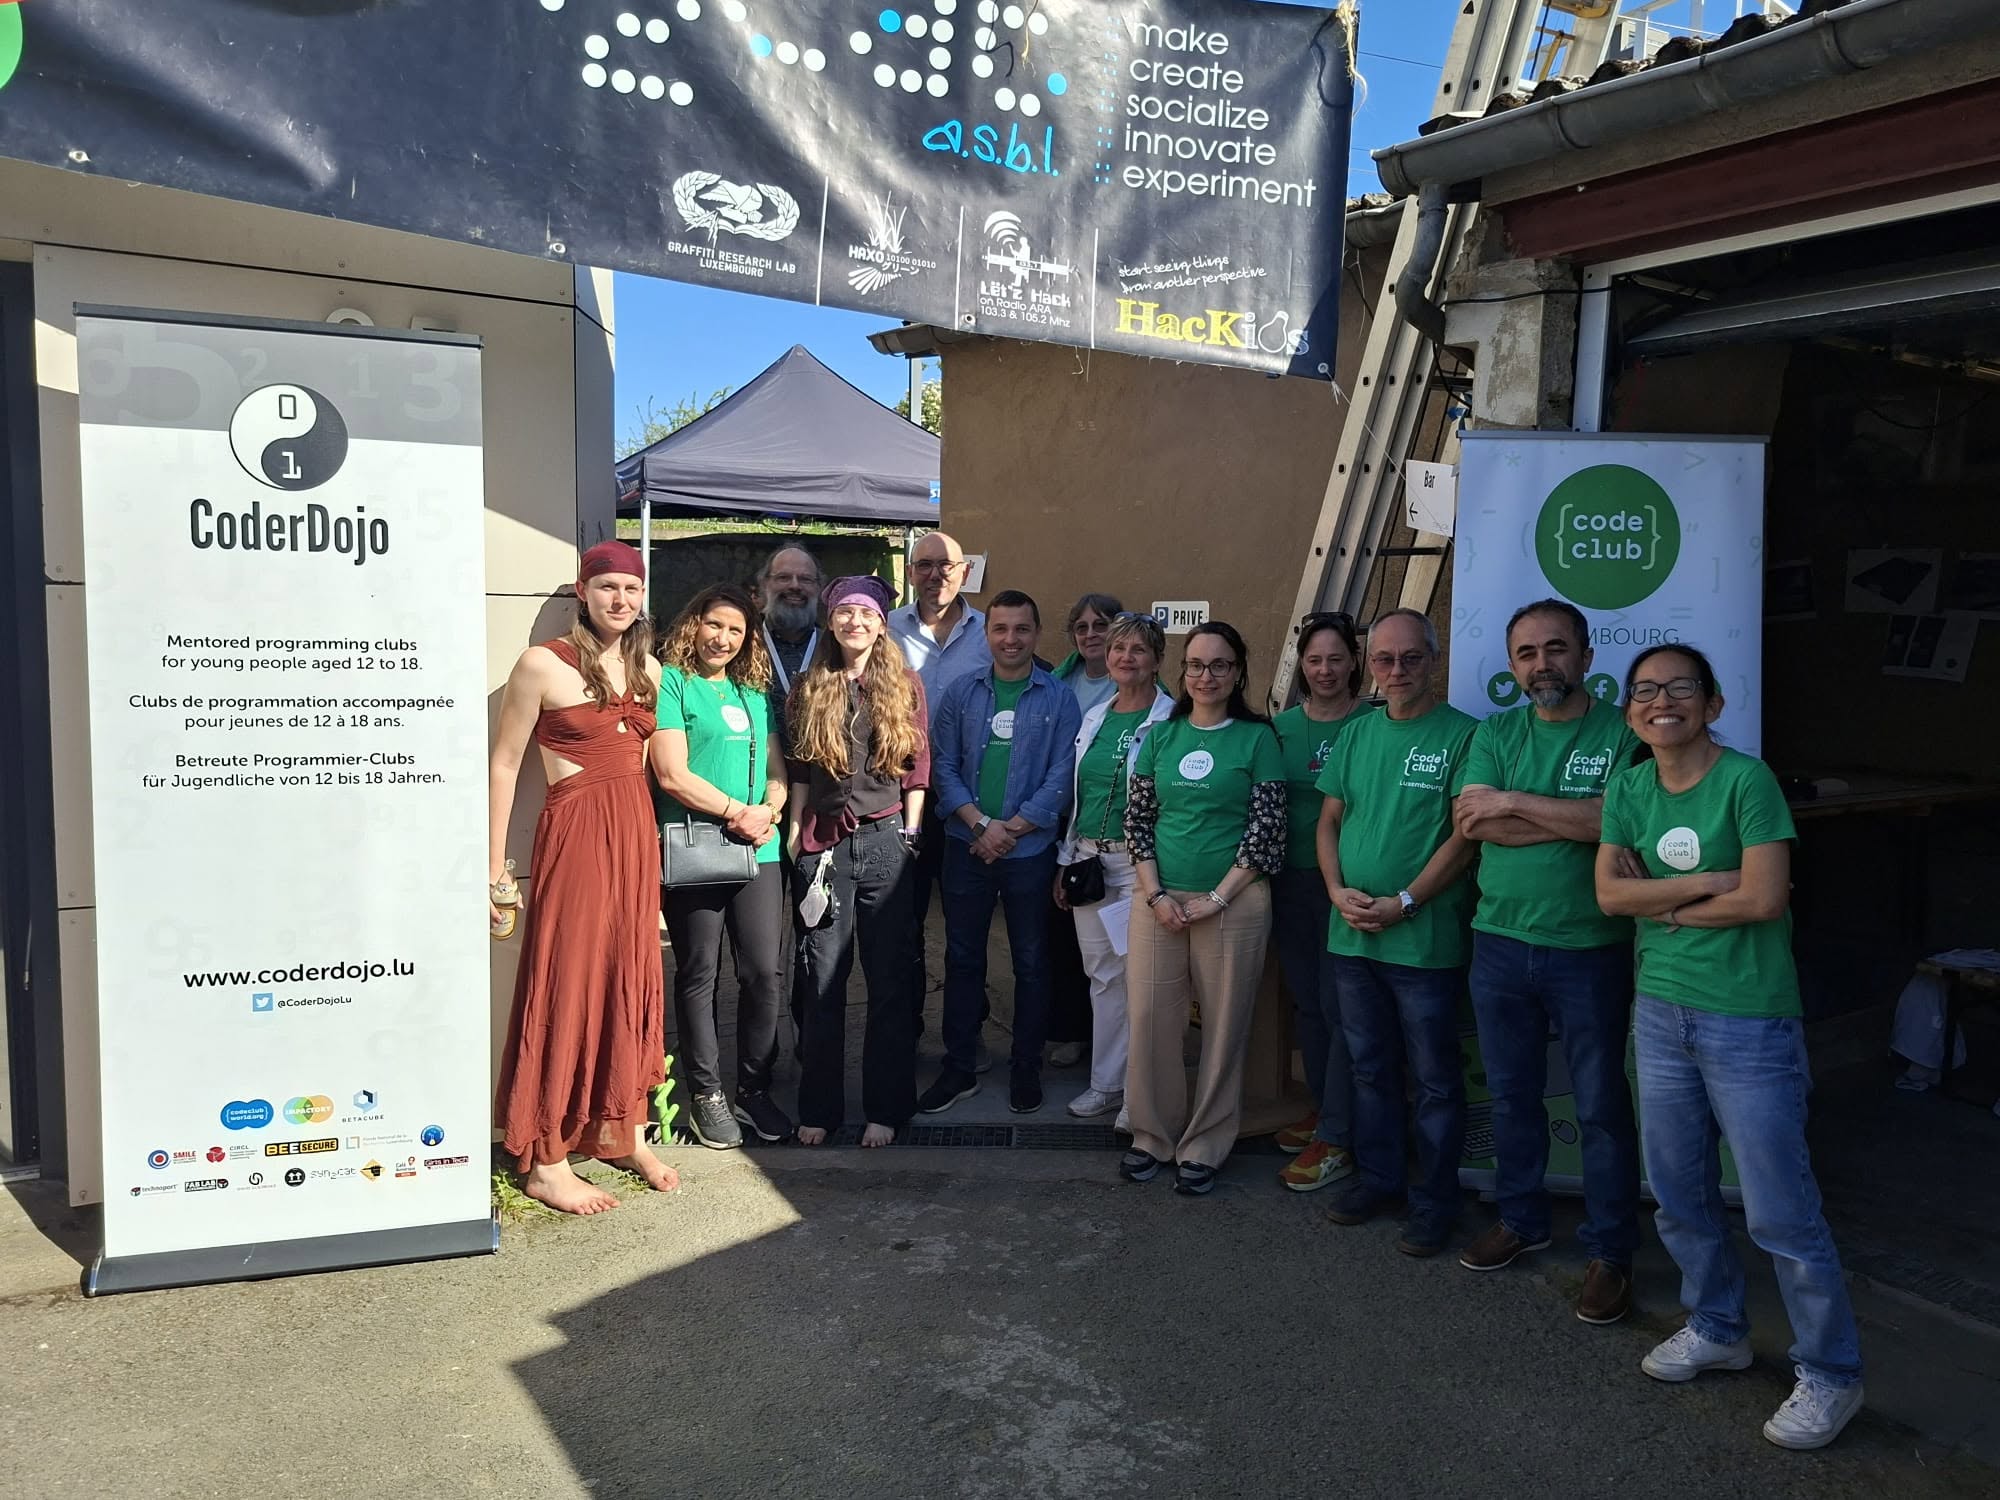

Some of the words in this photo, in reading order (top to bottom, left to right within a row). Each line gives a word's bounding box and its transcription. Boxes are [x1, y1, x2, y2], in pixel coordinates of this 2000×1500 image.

[1132, 20, 1229, 55] make
[1129, 58, 1244, 94] create
[1126, 93, 1270, 131] socialize
[921, 119, 1059, 177] a.s.b.l.
[1124, 127, 1277, 166] innovate
[1122, 164, 1317, 207] experiment
[668, 241, 715, 259] GRAFFITI
[718, 250, 772, 270] RESEARCH
[776, 261, 796, 273] LAB
[848, 245, 885, 263] HAXO
[886, 254, 910, 265] 10100
[911, 258, 936, 269] 01010
[700, 258, 764, 278] LUXEMBOURG
[1118, 262, 1152, 279] start
[1153, 258, 1191, 276] seeing
[1192, 255, 1230, 270] things
[1121, 281, 1153, 295] from
[1153, 273, 1200, 291] another
[1202, 266, 1268, 288] perspective
[980, 297, 994, 306] on
[996, 298, 1027, 311] Radio
[1029, 304, 1052, 315] ARA
[1031, 289, 1071, 308] Hack
[980, 306, 1007, 318] 103.3
[1009, 311, 1018, 319] &
[1021, 312, 1047, 324] 105.2
[1049, 316, 1071, 328] Mhz
[1424, 470, 1435, 488] Bar
[1572, 510, 1644, 532] code
[190, 498, 390, 566] CoderDojo
[1571, 538, 1642, 560] club
[1173, 610, 1204, 625] PRIVE
[167, 634, 250, 649] Mentored
[255, 637, 369, 653] programming
[374, 638, 417, 651] clubs
[1588, 627, 1680, 646] MBOURG
[161, 655, 186, 668] for
[190, 657, 244, 672] young
[249, 656, 307, 672] people
[311, 657, 352, 672] aged
[356, 657, 375, 670] 12
[379, 658, 396, 670] to
[400, 657, 423, 670] 18.
[129, 694, 178, 708] Clubs
[182, 695, 204, 708] de
[208, 695, 338, 711] programmation
[342, 696, 455, 711] accompagnée
[185, 717, 225, 731] pour
[228, 714, 284, 731] jeunes
[288, 714, 309, 728] de
[313, 714, 332, 728] 12
[336, 714, 345, 728] à
[350, 714, 369, 728] 18
[373, 716, 405, 728] ans.
[175, 754, 249, 767] Betreute
[253, 752, 415, 769] Programmier-Clubs
[1411, 761, 1437, 772] club
[1412, 752, 1442, 764] code
[1574, 755, 1606, 765] code
[1573, 765, 1602, 775] club
[142, 774, 167, 788] für
[171, 773, 275, 790] Jugendliche
[279, 775, 310, 787] von
[315, 772, 333, 785] 12
[338, 771, 360, 785] bis
[365, 771, 383, 784] 18
[388, 771, 446, 784] Jahren.
[1399, 780, 1444, 792] Luxembourg
[1560, 784, 1603, 794] Luxembour
[1667, 840, 1689, 848] code
[1667, 849, 1689, 857] club
[183, 958, 415, 988] www.coderdojo.lu
[277, 995, 352, 1010] @CoderDojoLu
[342, 1114, 385, 1123] BETACUBE
[173, 1150, 196, 1159] SMILE
[266, 1143, 299, 1156] BEE
[301, 1141, 336, 1152] SECURE
